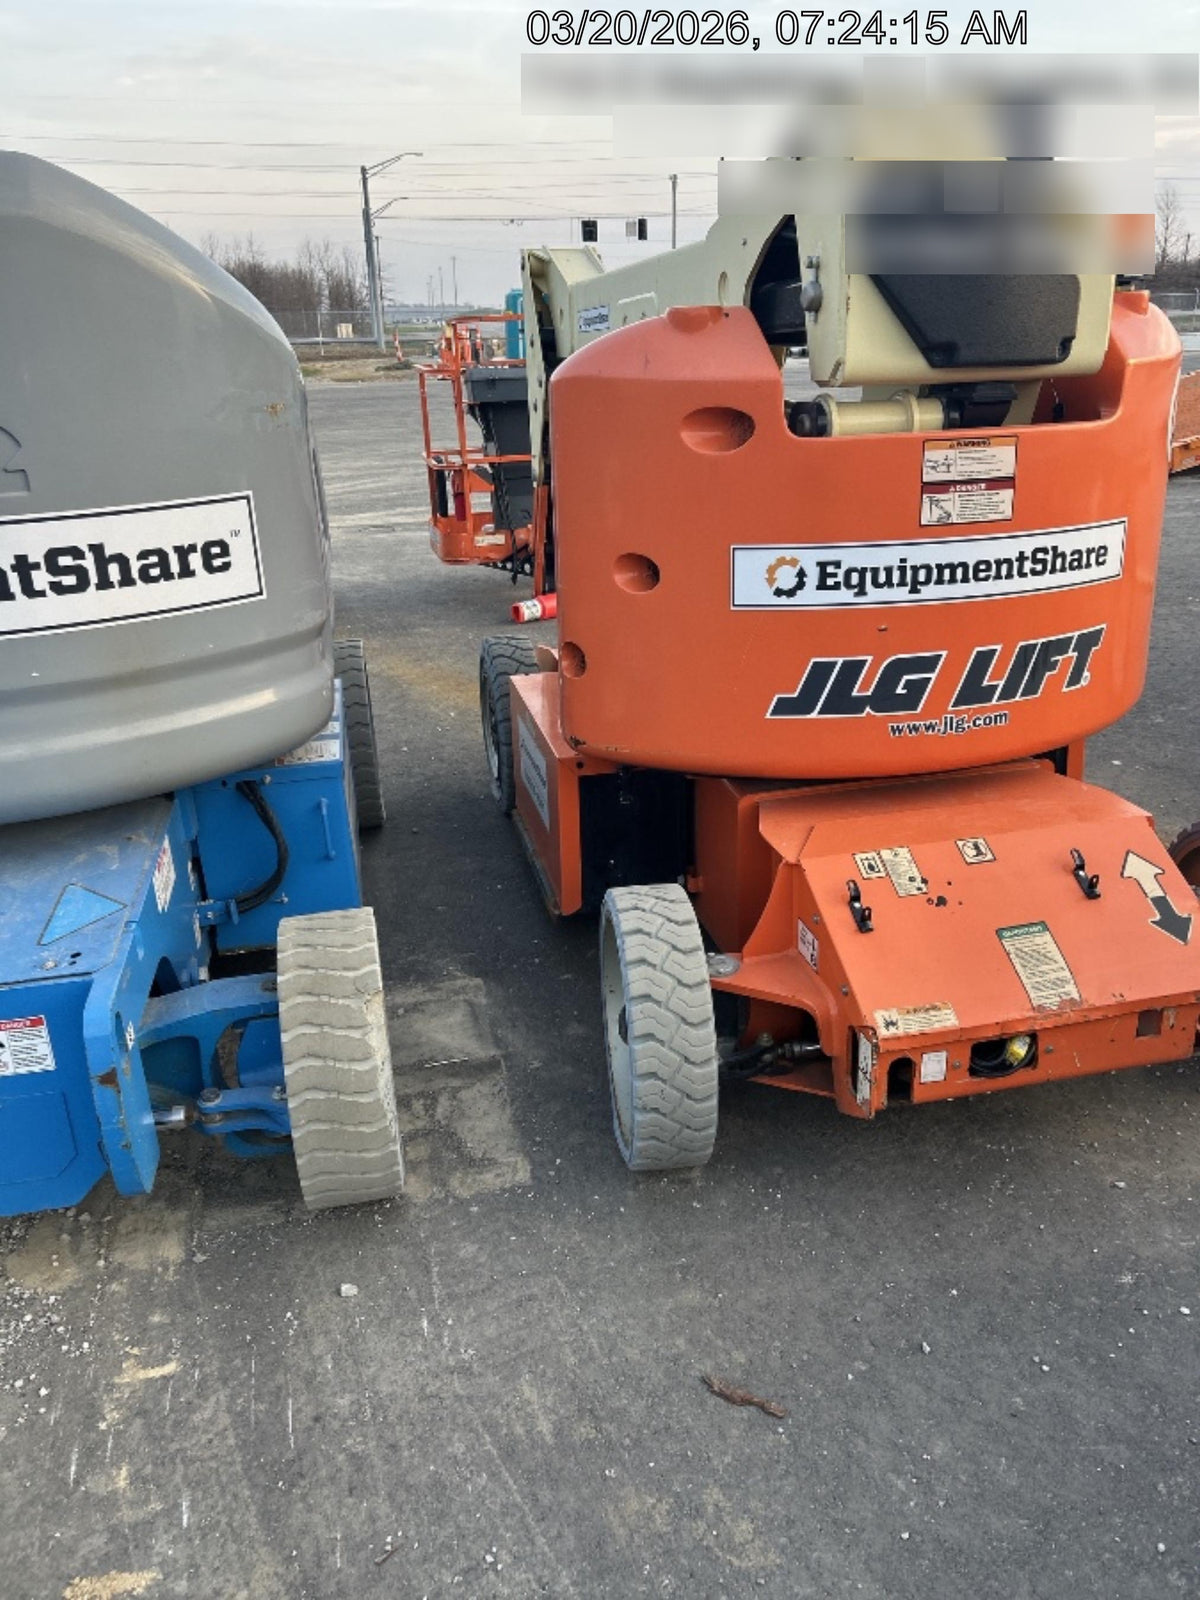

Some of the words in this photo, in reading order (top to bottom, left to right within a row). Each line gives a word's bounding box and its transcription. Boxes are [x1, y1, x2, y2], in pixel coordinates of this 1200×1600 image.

[816, 544, 1109, 597] EquipmentShare
[766, 652, 947, 717] JLG
[948, 624, 1107, 711] LIFT
[888, 711, 1009, 737] www.jlg.com
